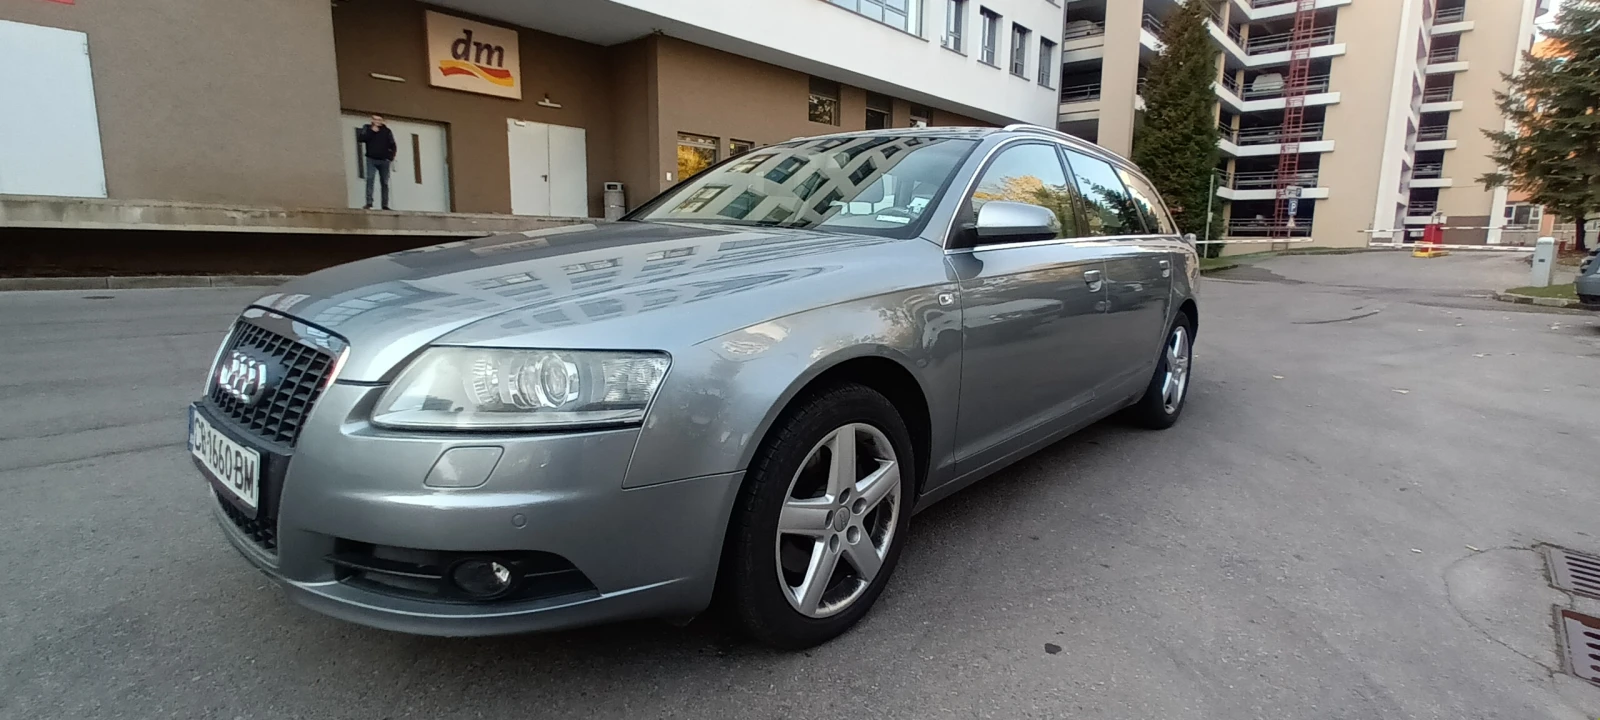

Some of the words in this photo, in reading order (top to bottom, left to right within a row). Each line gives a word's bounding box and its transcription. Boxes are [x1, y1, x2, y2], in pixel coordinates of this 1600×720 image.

[451, 28, 504, 68] dm
[208, 429, 232, 481] 1660
[235, 450, 254, 499] BM
